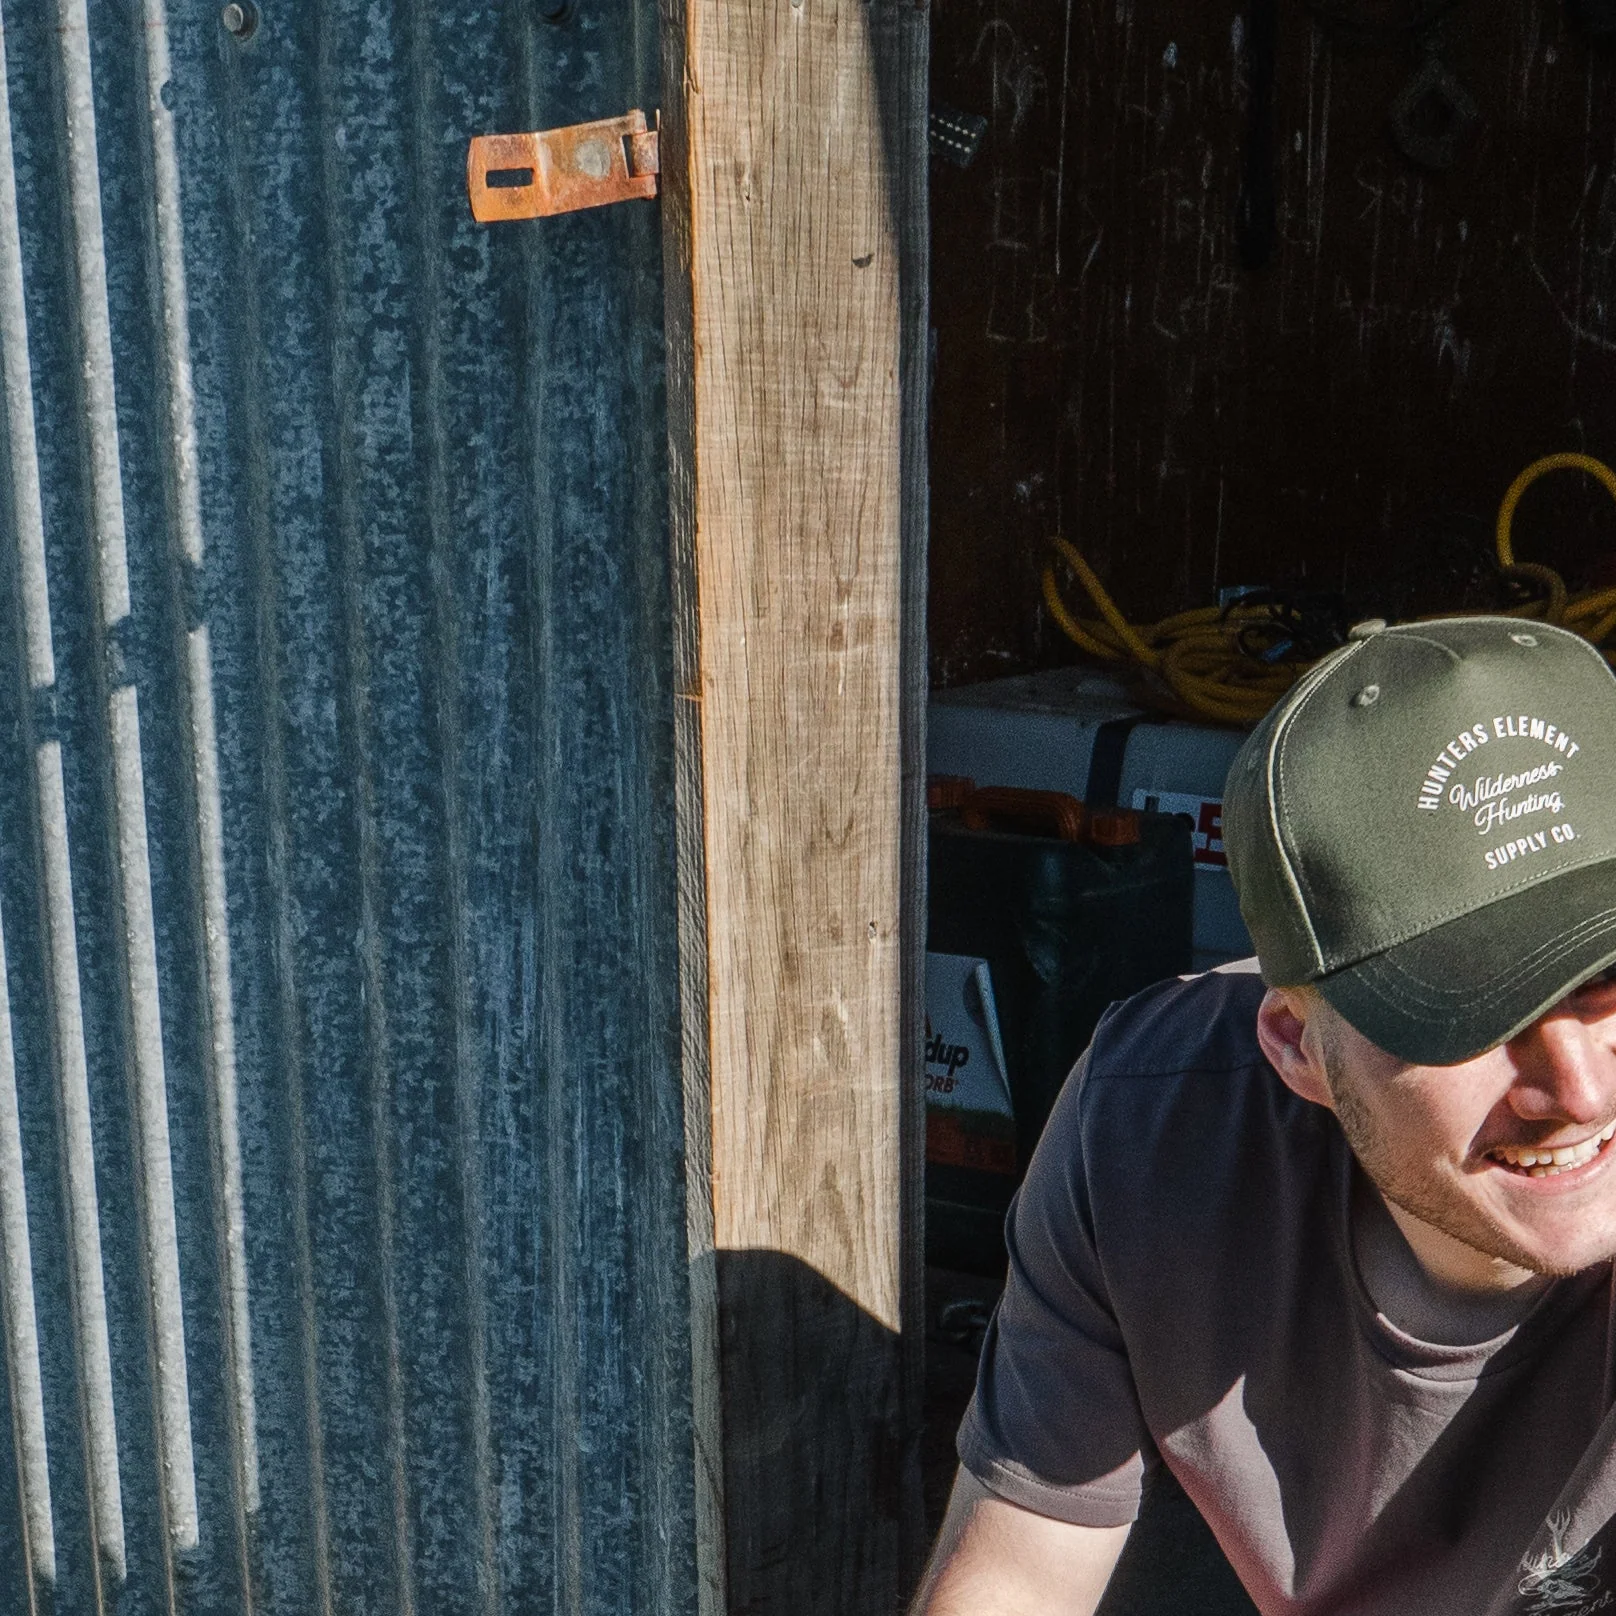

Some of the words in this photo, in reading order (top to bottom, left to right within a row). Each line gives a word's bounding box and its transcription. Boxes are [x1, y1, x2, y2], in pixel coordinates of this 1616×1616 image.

[1417, 723, 1489, 810] HUNTERS
[1493, 715, 1580, 758] ELEMENT
[1448, 761, 1563, 811] Wilderness
[1474, 792, 1565, 835] Hunting
[1484, 831, 1547, 870] SUPPLY
[925, 1033, 969, 1077] dup
